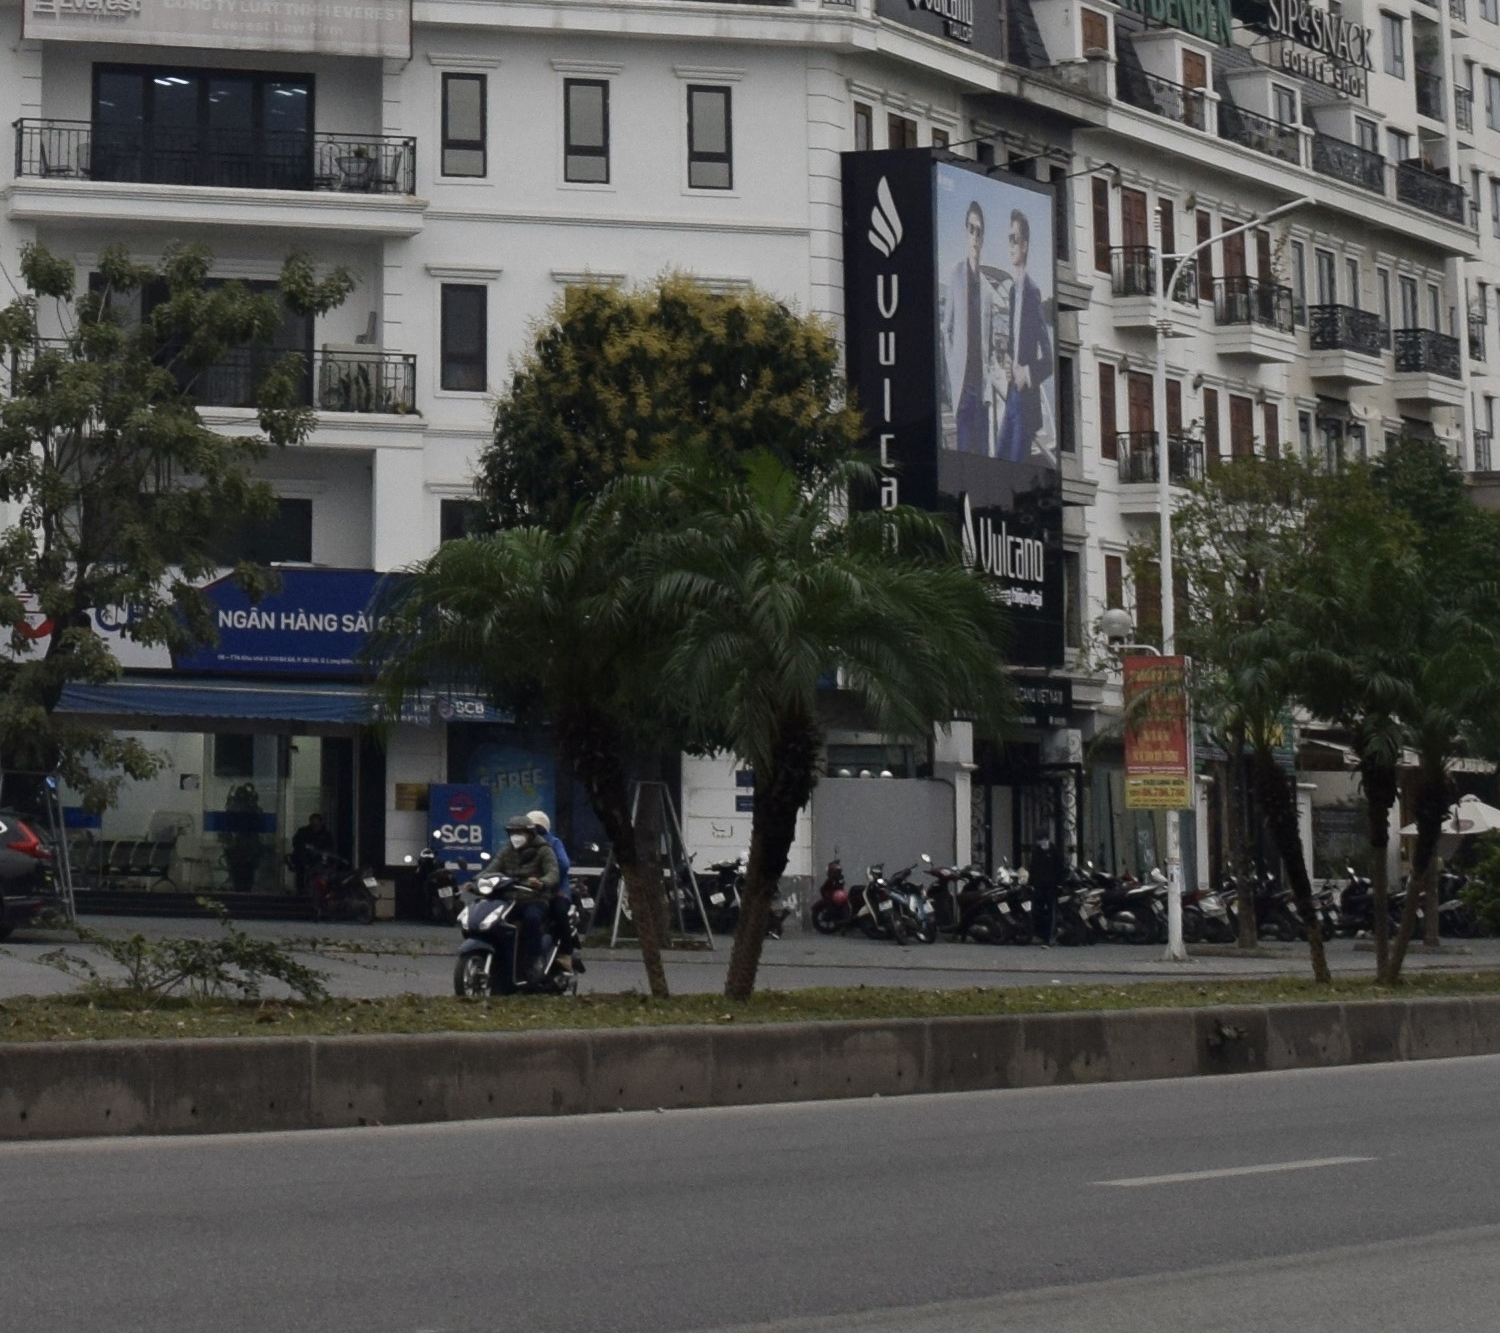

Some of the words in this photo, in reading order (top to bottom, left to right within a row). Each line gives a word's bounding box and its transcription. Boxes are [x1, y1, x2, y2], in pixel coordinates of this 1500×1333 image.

[334, 4, 405, 22] EVEREST
[876, 273, 899, 555] Vulcan
[979, 516, 1045, 583] Vulcano
[218, 607, 276, 630] NGÂN
[280, 608, 338, 633] HÀNG
[341, 611, 375, 633] SÀI
[455, 700, 485, 715] SCB
[441, 824, 483, 844] SCB
